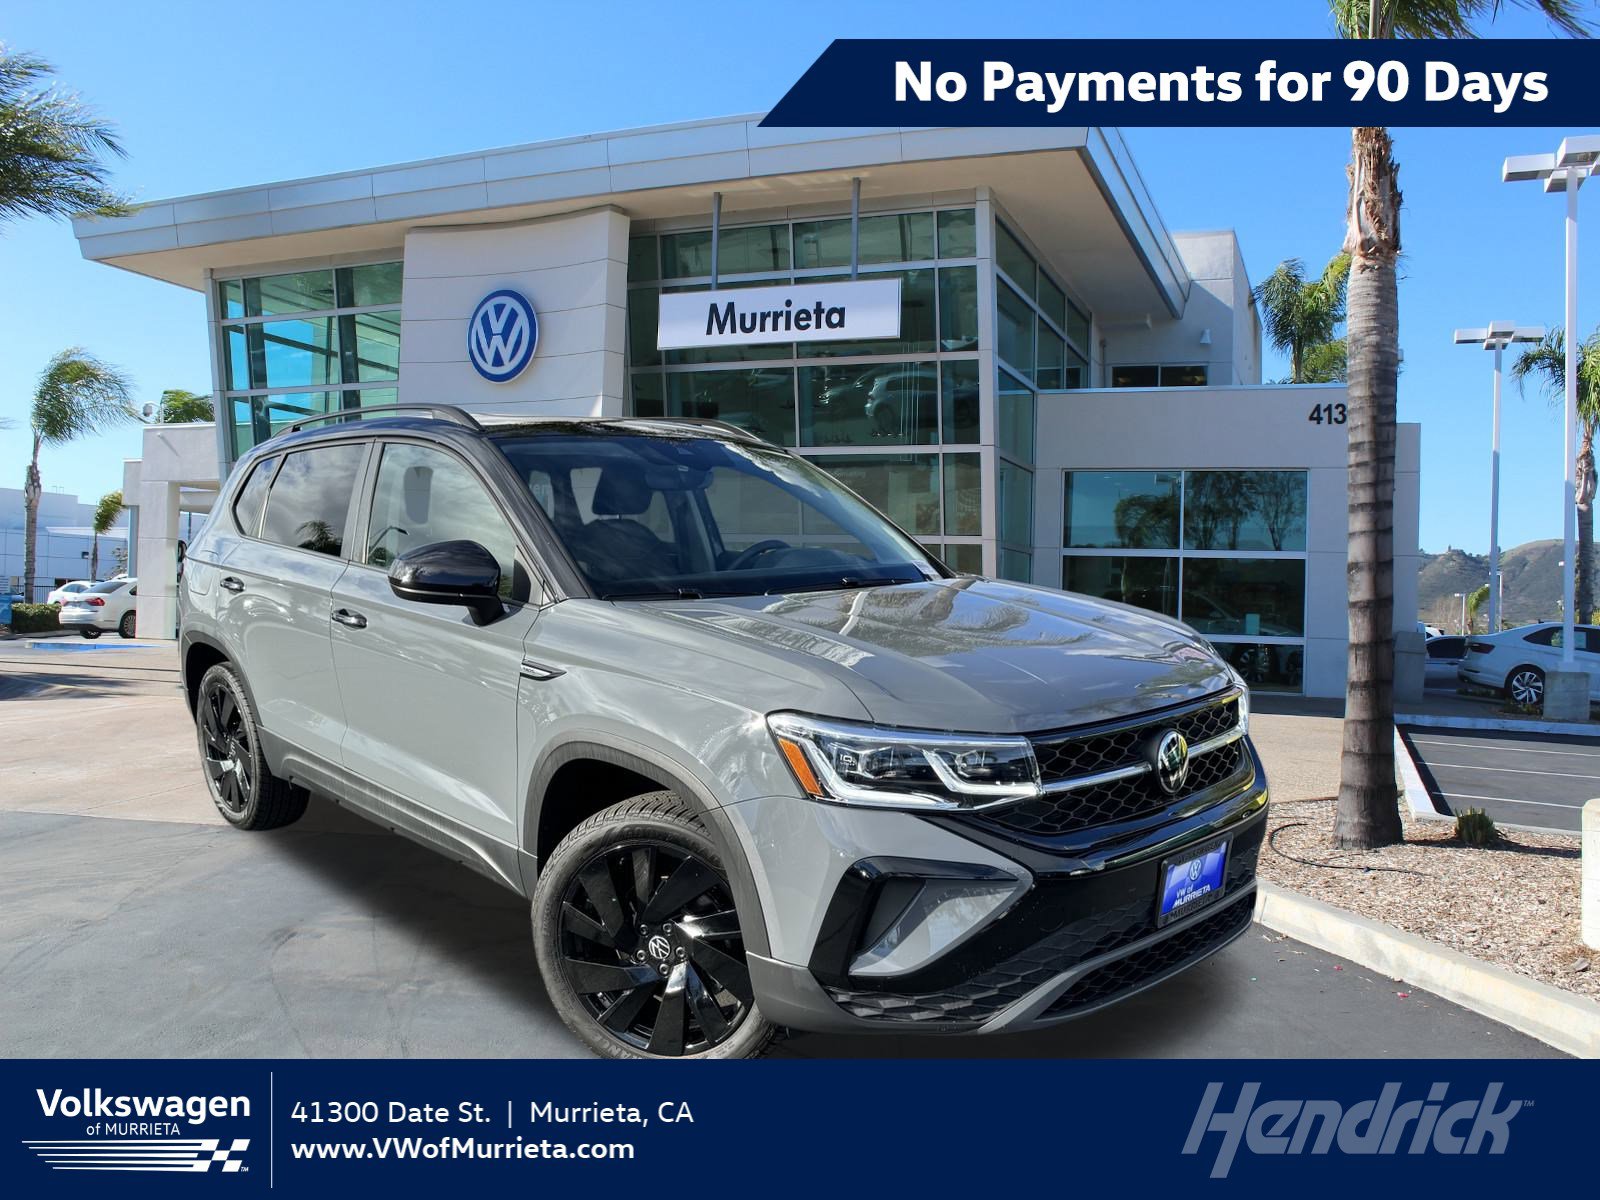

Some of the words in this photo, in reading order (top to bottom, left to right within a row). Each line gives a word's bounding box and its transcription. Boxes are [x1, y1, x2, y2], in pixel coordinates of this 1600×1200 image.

[705, 299, 846, 336] Murrieta
[1172, 884, 1211, 909] MURRIETA
[1176, 887, 1187, 899] VW
